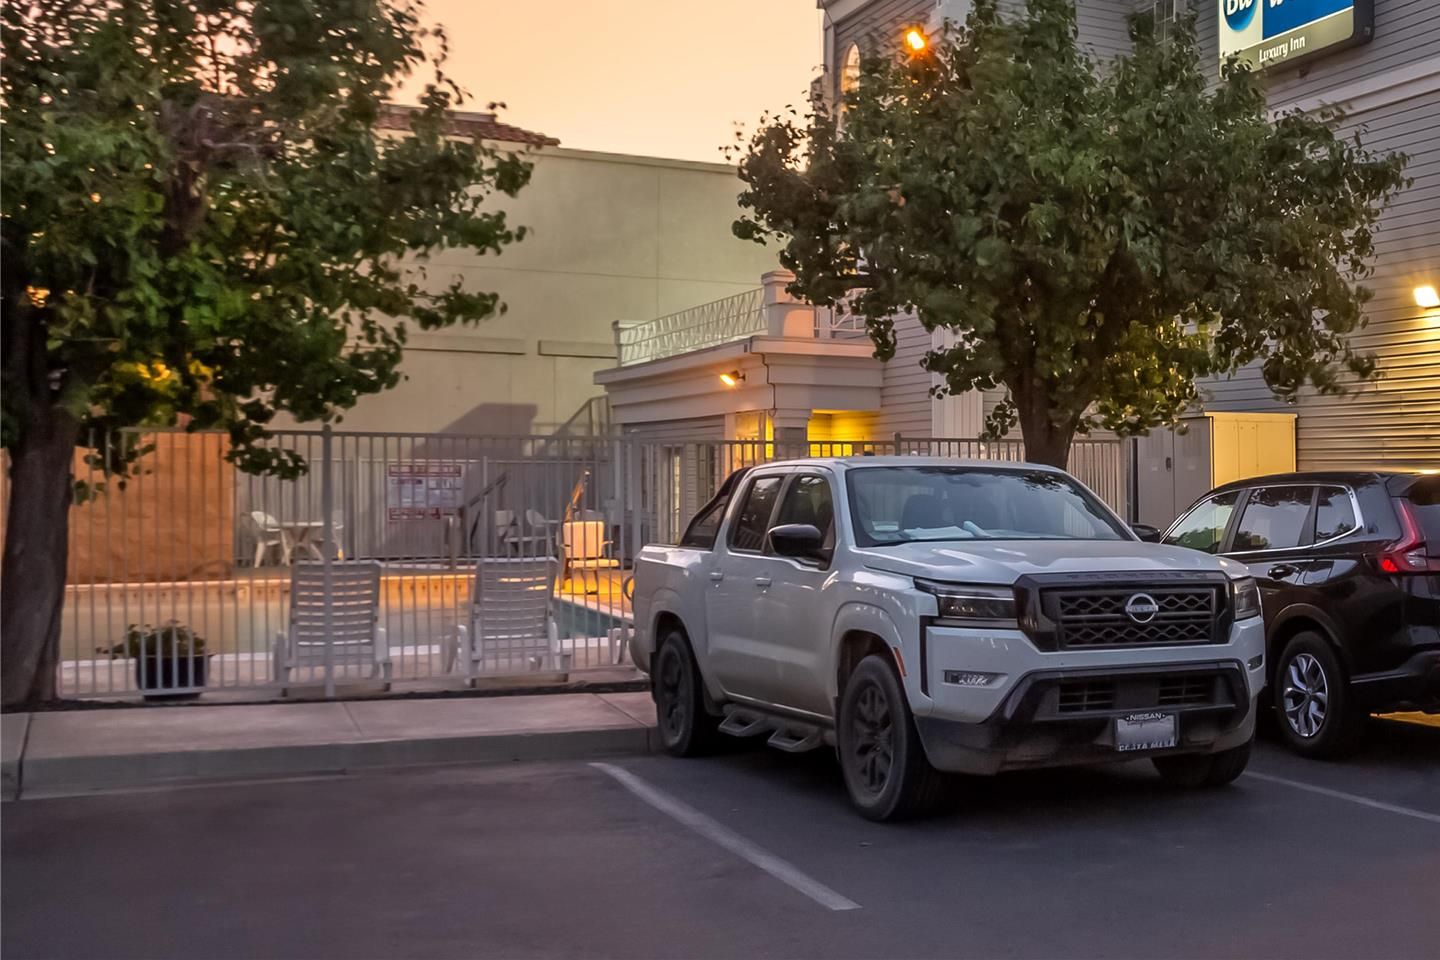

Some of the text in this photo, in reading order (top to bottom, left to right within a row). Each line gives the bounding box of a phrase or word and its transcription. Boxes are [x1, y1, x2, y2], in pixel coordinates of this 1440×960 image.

[1259, 36, 1306, 62] Luxury Inn
[1129, 712, 1162, 721] NISSAN
